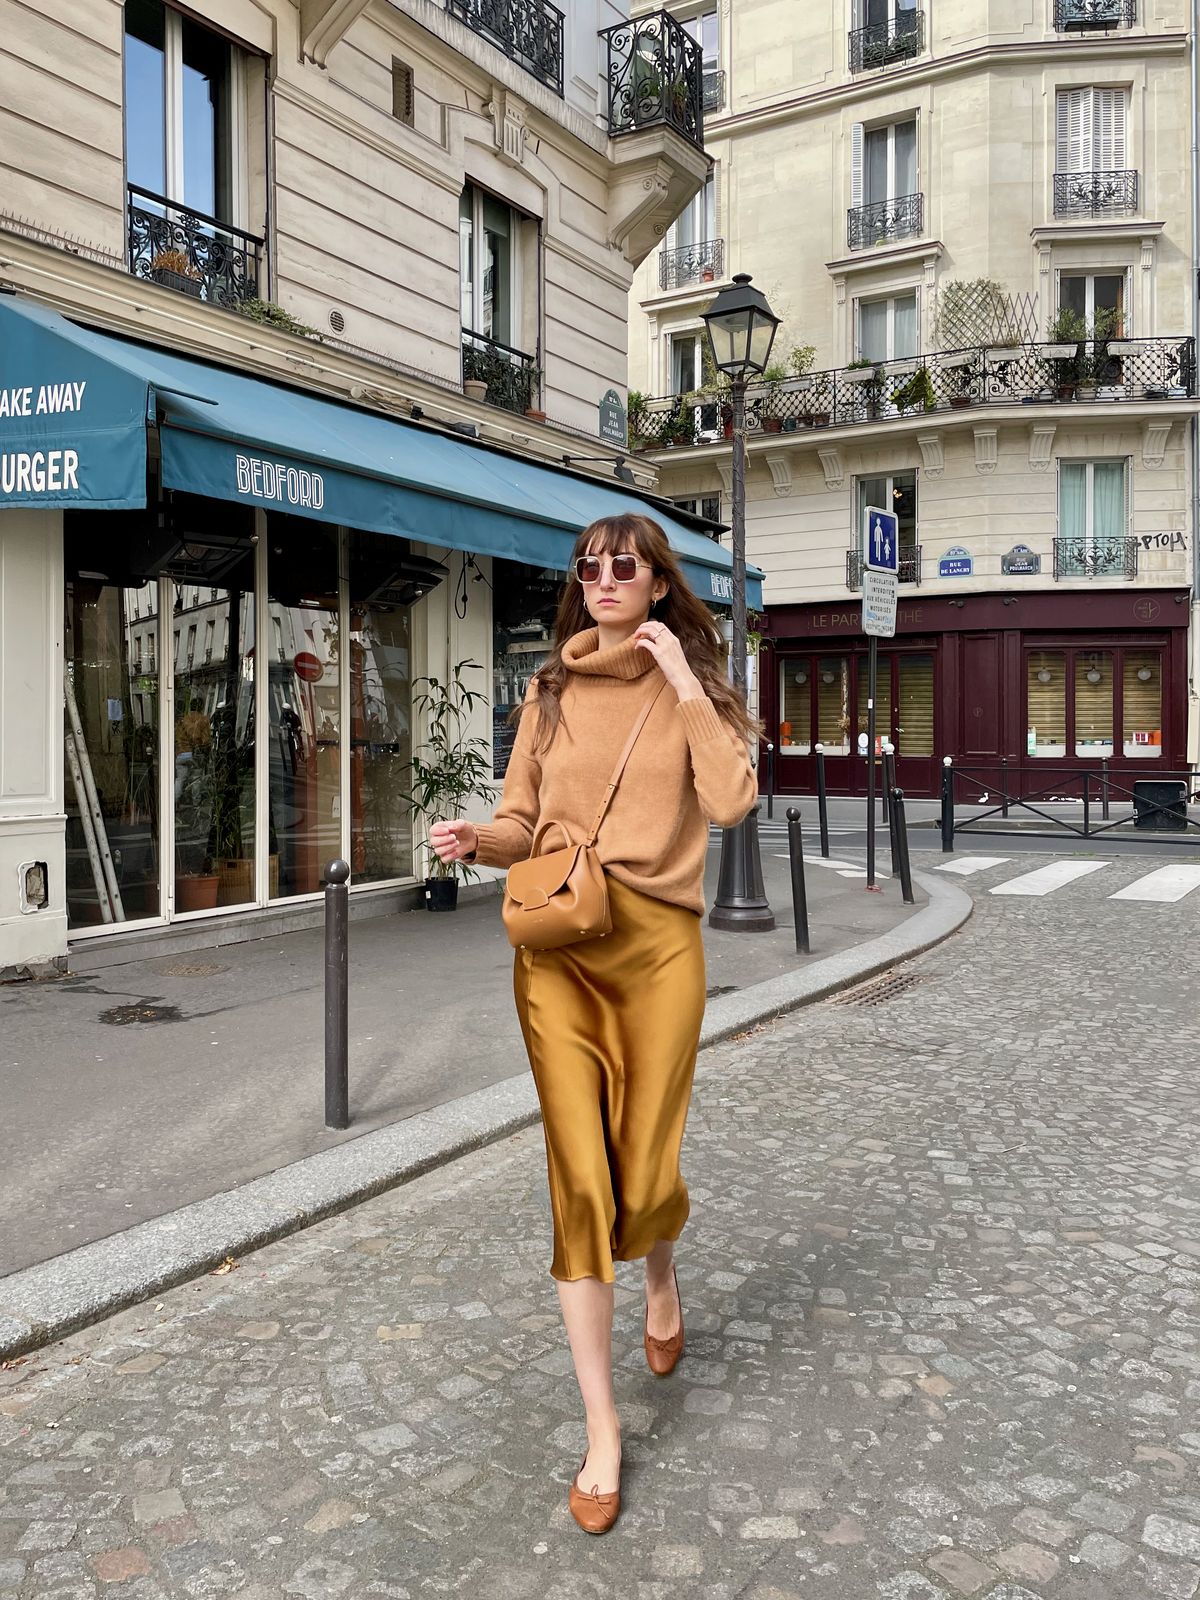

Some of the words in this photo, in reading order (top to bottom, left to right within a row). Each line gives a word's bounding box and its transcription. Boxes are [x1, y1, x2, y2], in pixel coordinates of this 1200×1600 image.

[0, 387, 33, 418] AKE
[36, 381, 86, 415] AWAY
[2, 449, 79, 494] URGER
[236, 454, 324, 510] BEDFORD
[710, 572, 733, 599] BEDFO
[813, 614, 828, 628] LE
[831, 612, 861, 626] PAR
